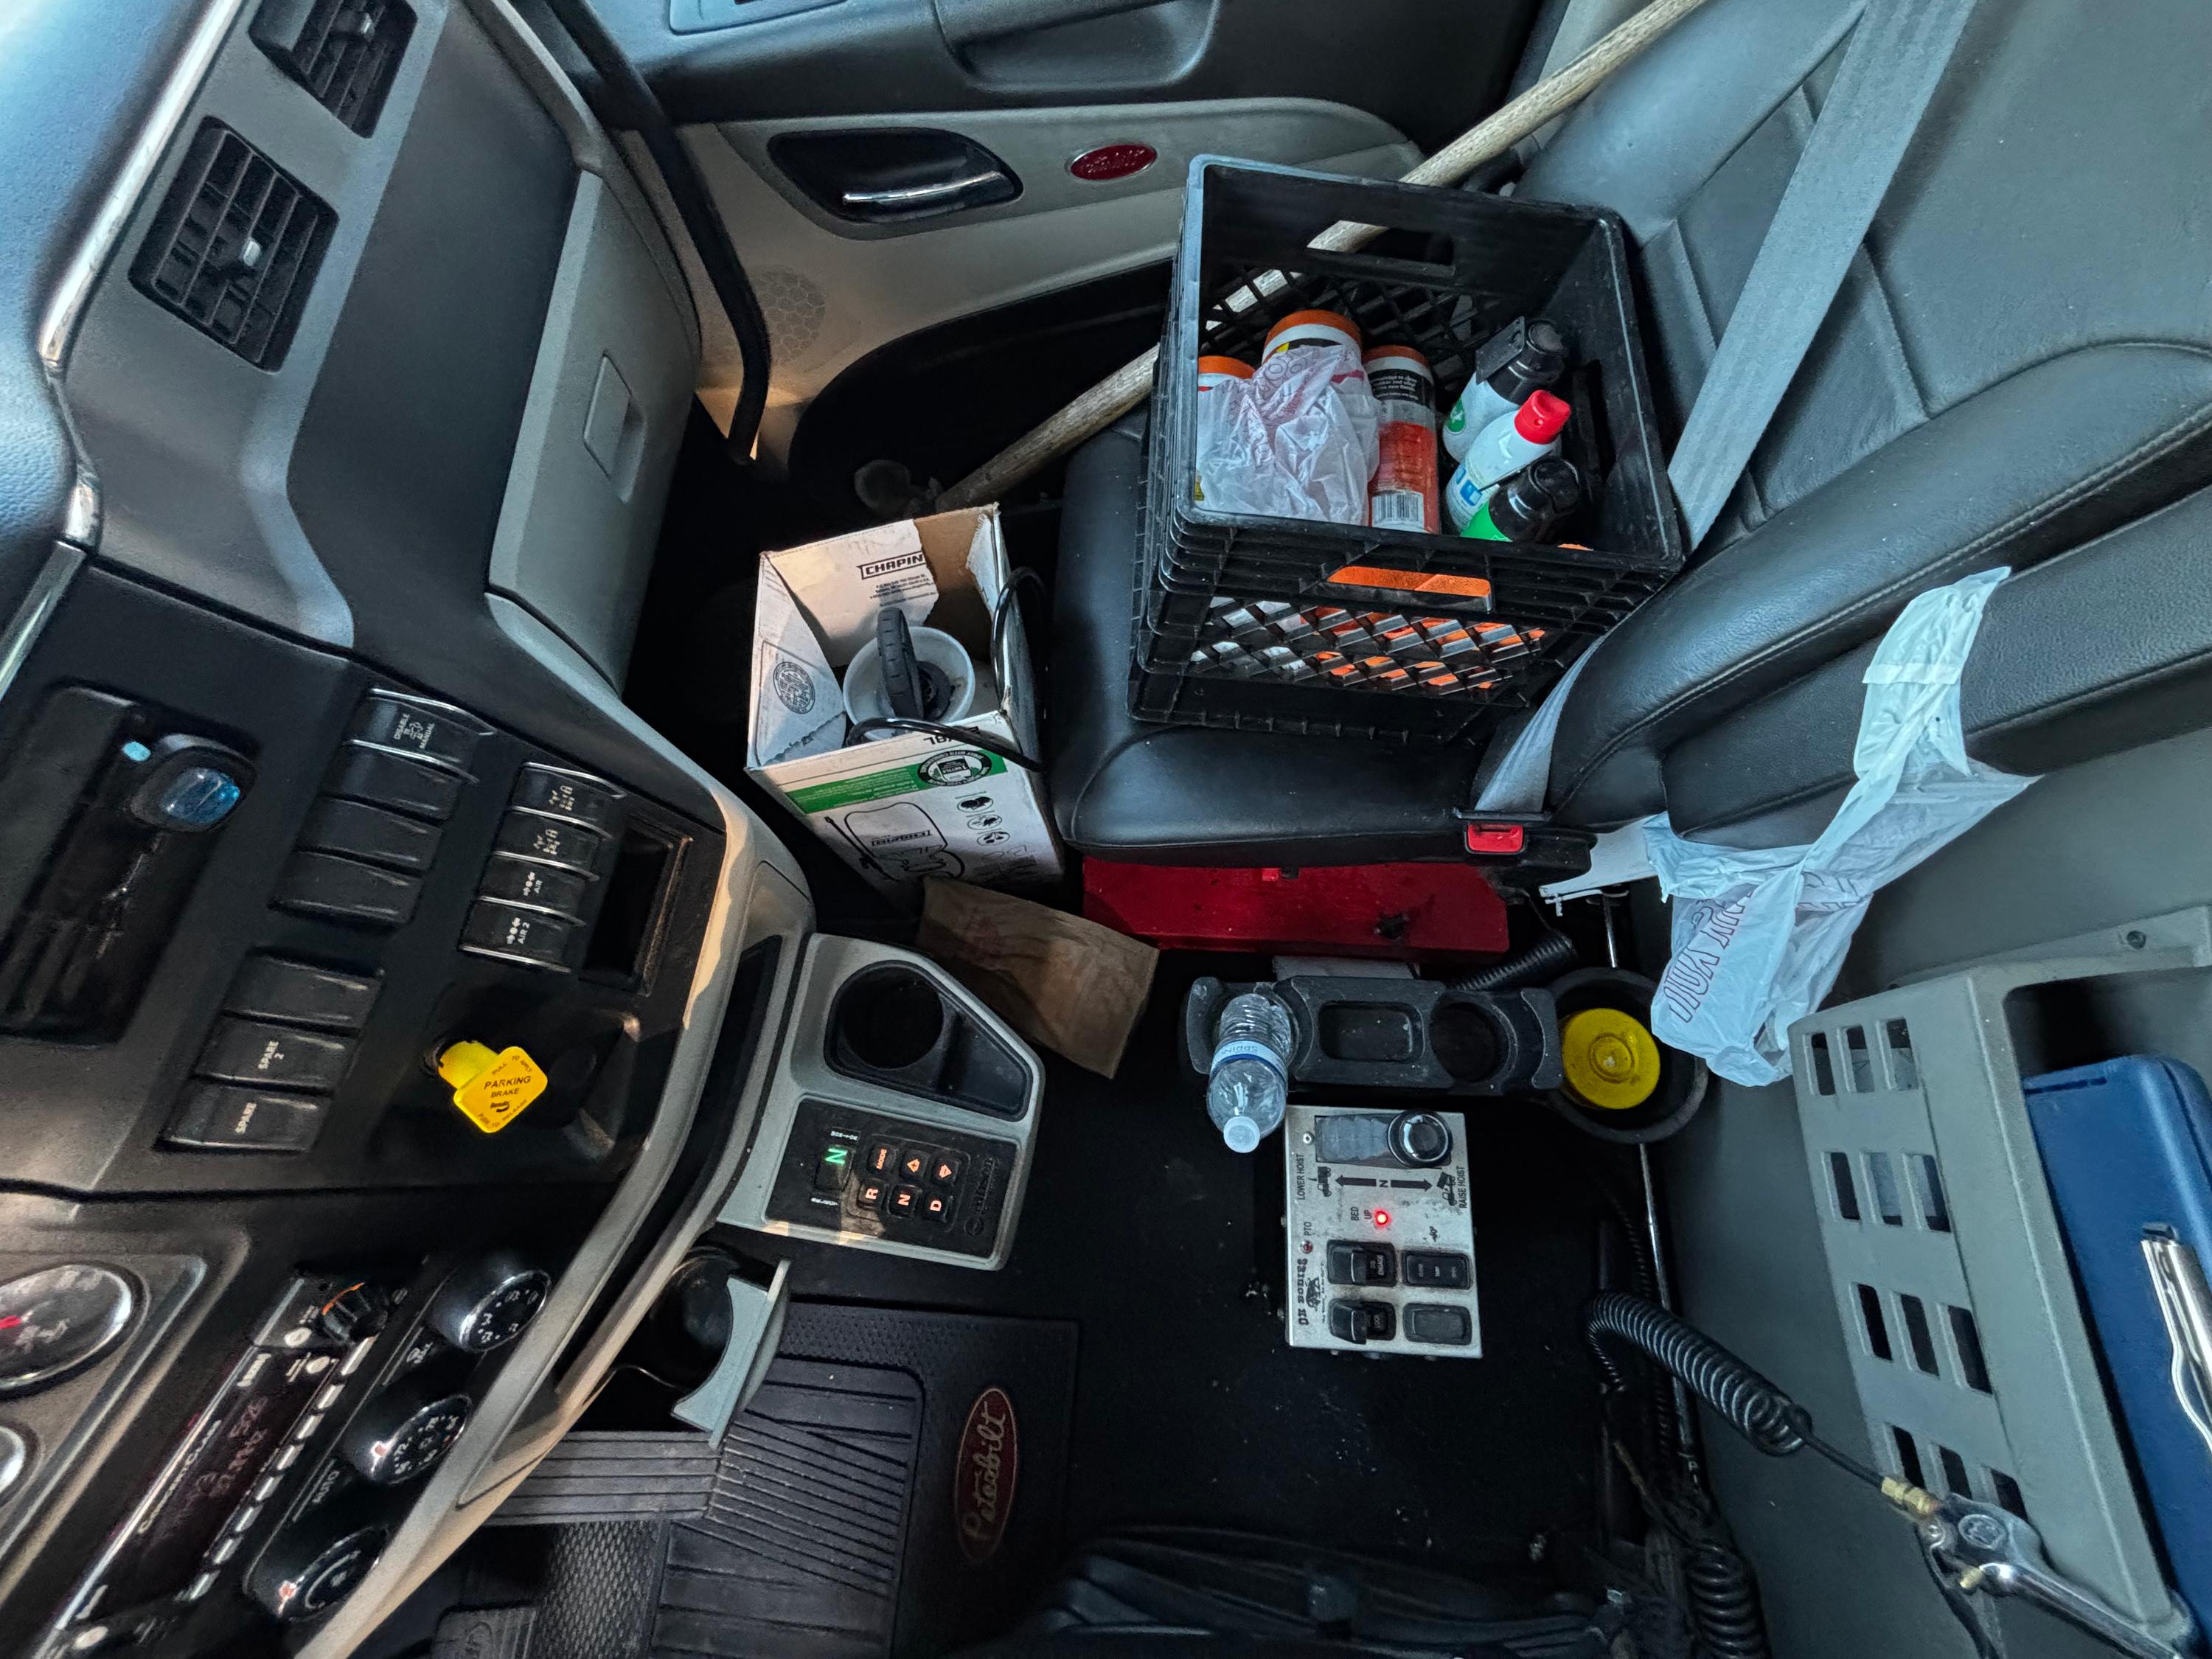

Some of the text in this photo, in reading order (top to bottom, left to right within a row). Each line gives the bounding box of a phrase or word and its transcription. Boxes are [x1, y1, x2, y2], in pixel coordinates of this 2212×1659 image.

[865, 554, 923, 575] CHAPIN
[394, 713, 410, 740] DISABLE
[419, 723, 435, 749] MANUAL
[534, 880, 543, 894] AIR
[518, 929, 529, 945] AIR
[257, 1040, 279, 1069] SPARE
[484, 1076, 532, 1090] PARKING
[490, 1088, 520, 1098] BRAKE
[234, 1102, 257, 1133] SPARE
[825, 1147, 848, 1166] N
[876, 1148, 887, 1170] MODE
[1295, 1154, 1306, 1200] LOWER HOIST
[1379, 1180, 1389, 1188] N
[1455, 1166, 1468, 1208] RAISE HOIST
[865, 1187, 942, 1212] R N D
[1350, 1206, 1360, 1221] BED
[1363, 1209, 1372, 1220] UP
[1303, 1221, 1312, 1236] PTO
[1297, 1258, 1310, 1326] OX BODIES
[961, 1401, 1007, 1542] Peterbilt
